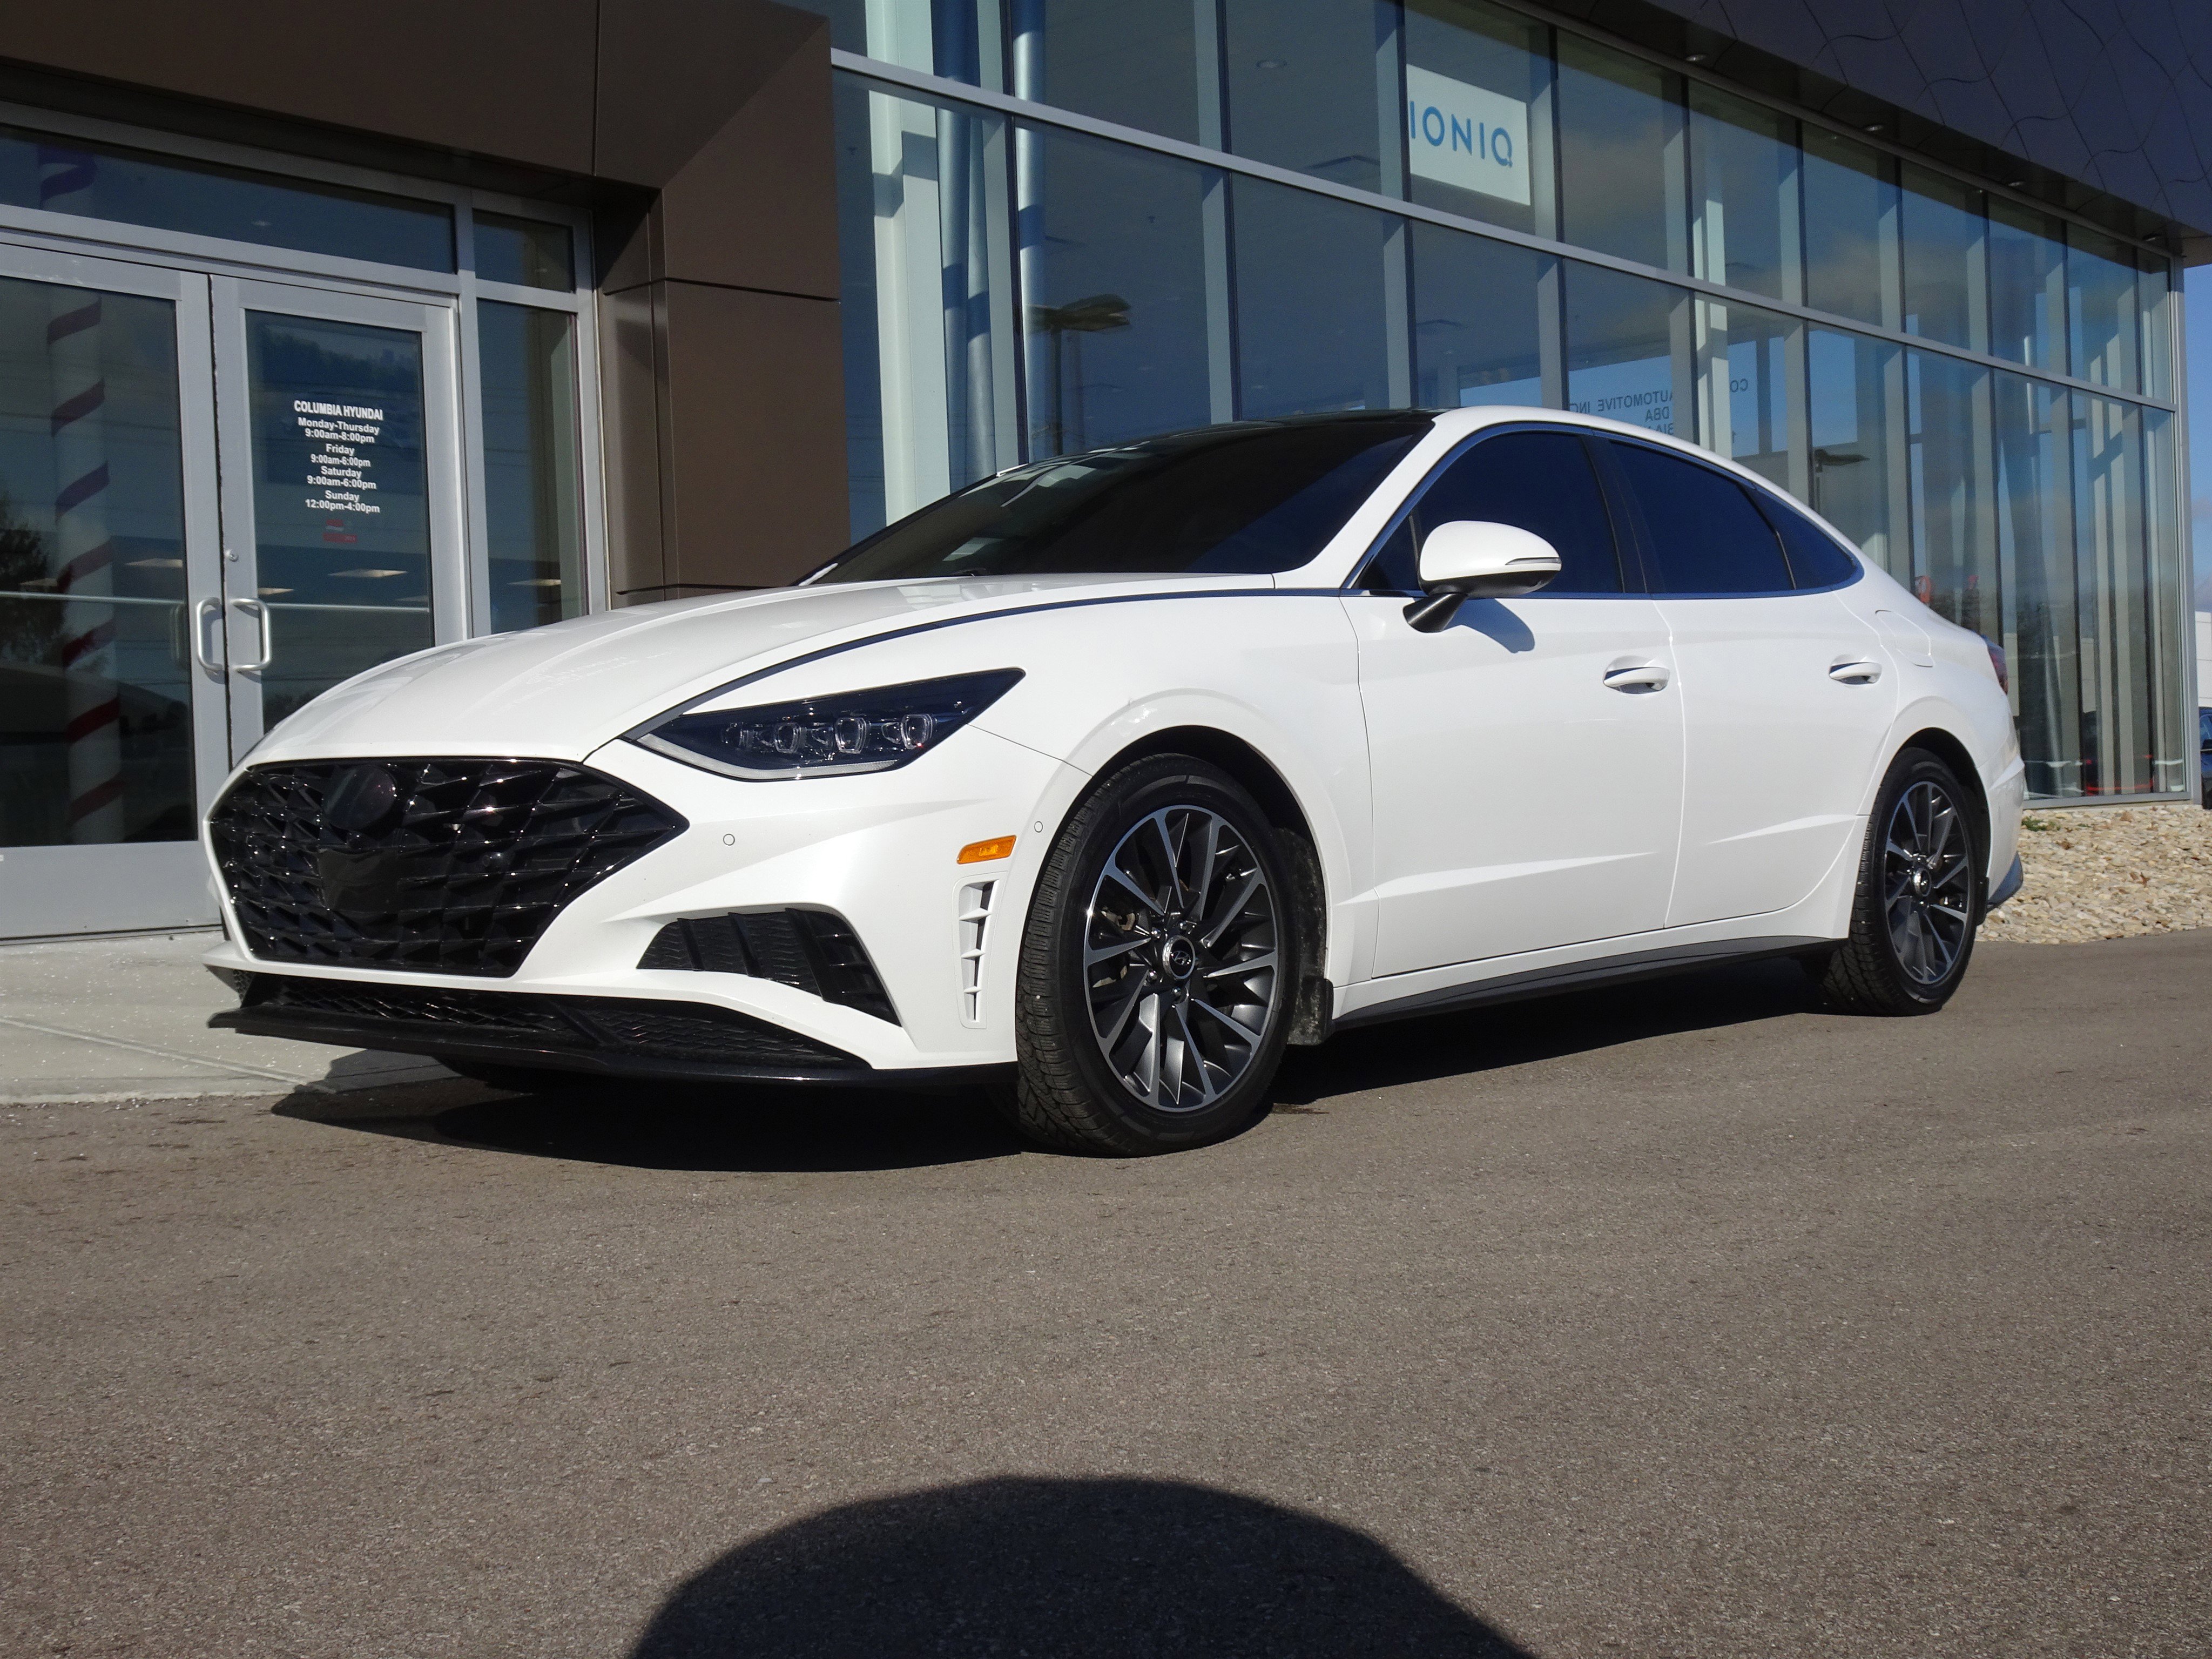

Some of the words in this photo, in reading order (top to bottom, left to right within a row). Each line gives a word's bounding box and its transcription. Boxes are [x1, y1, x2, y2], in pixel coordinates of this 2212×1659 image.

[1410, 100, 1513, 168] IONIQ
[294, 400, 342, 416] COLUMBIA
[343, 405, 383, 421] HYUNDAI
[298, 417, 380, 435] Monday-Thursday
[305, 428, 375, 443] 9:00am-8:00pm
[326, 443, 355, 457] Friday
[311, 454, 371, 468] 9:00am-6:00pm
[321, 466, 362, 479] Saturday
[307, 475, 376, 490] 9:00am-6:00pm
[325, 490, 360, 503] Sunday
[305, 499, 380, 514] 12:00pm-4:00pm
